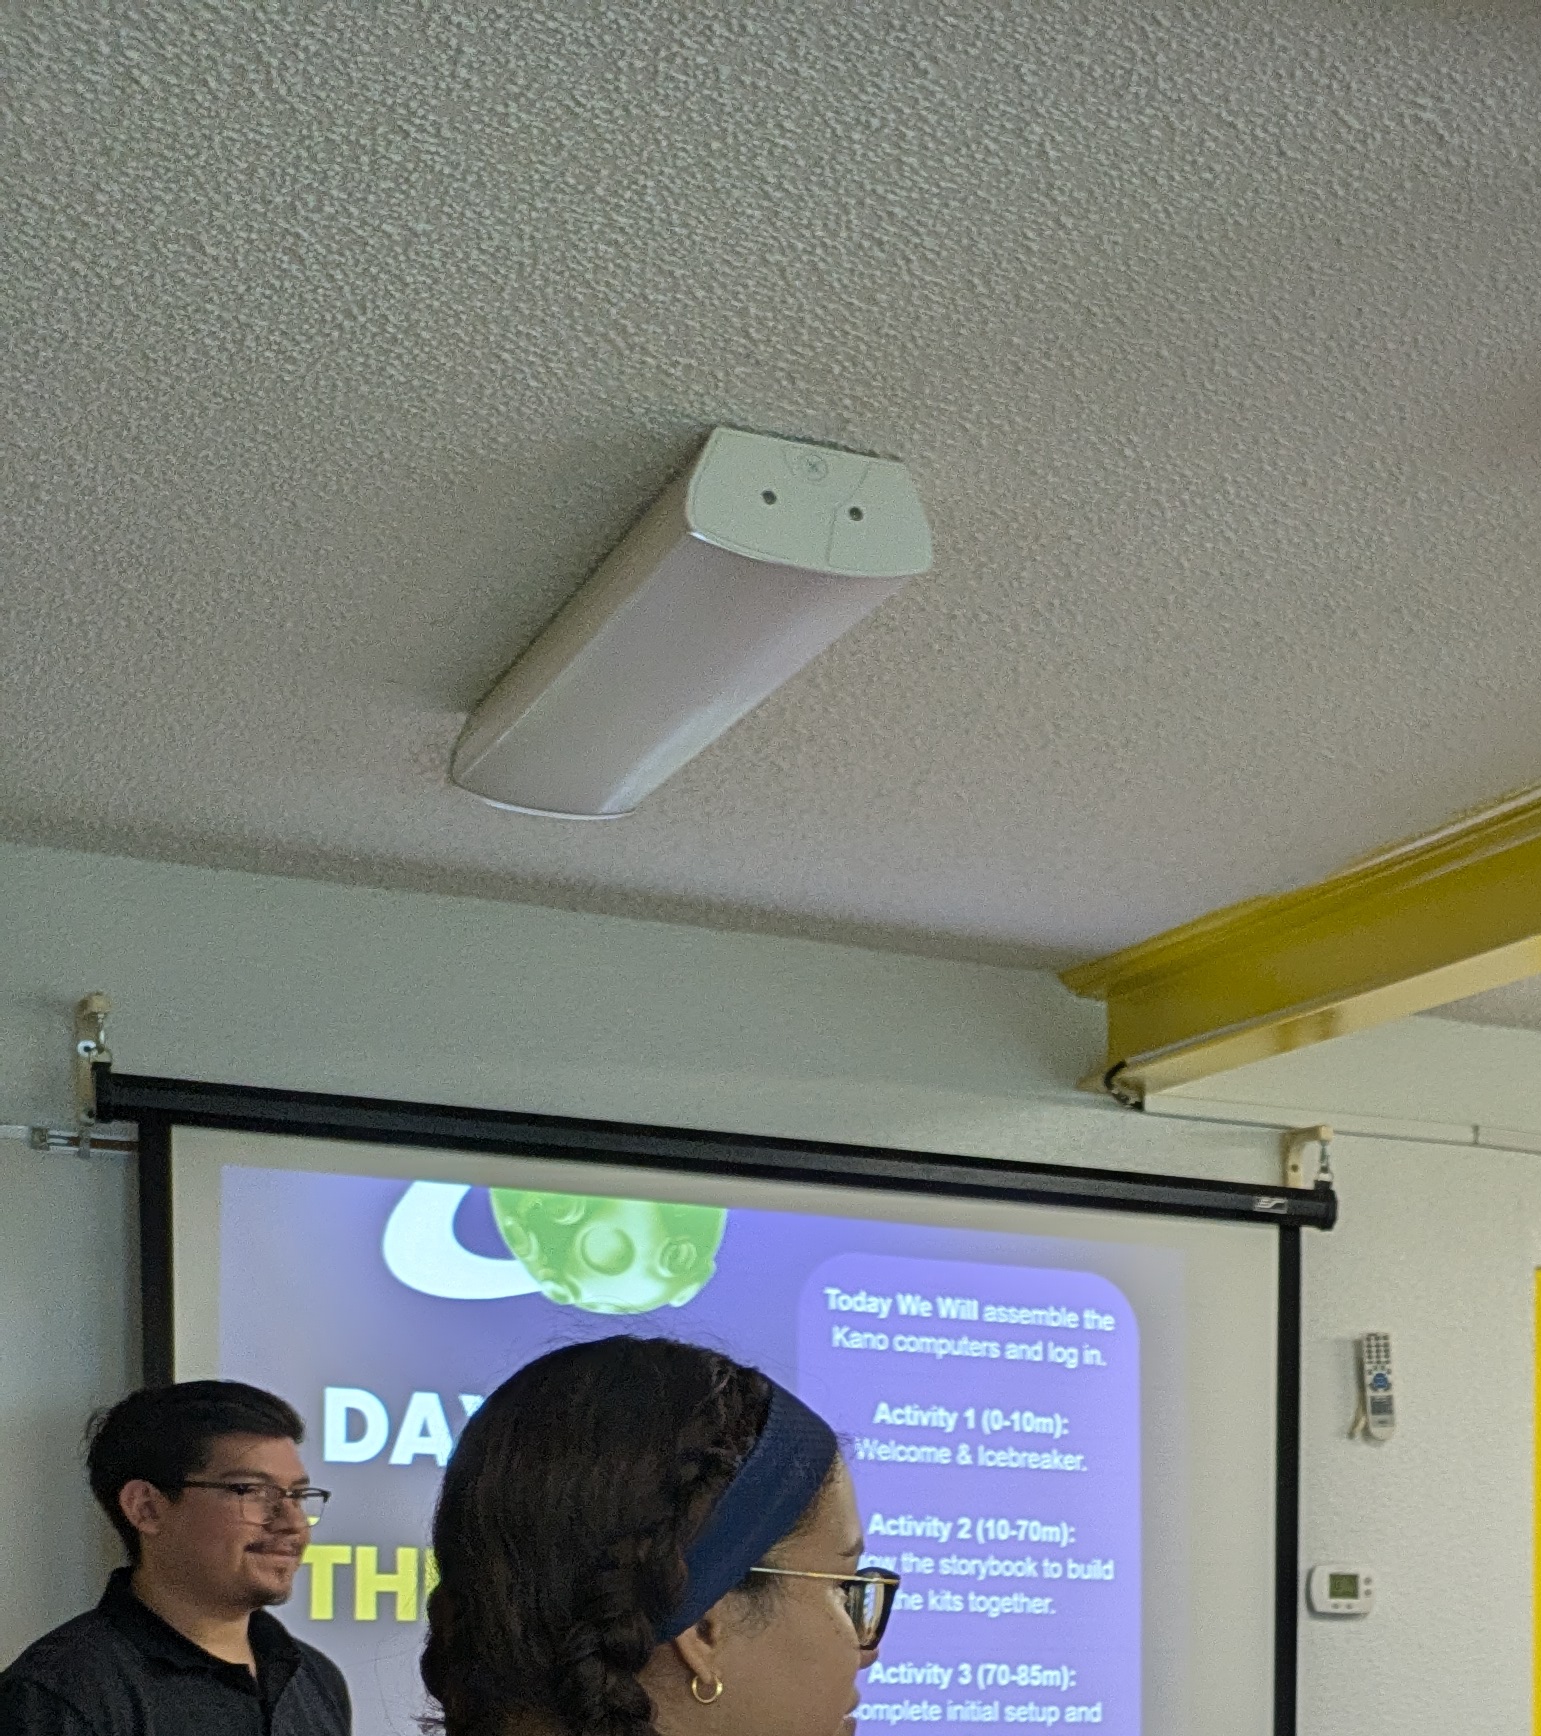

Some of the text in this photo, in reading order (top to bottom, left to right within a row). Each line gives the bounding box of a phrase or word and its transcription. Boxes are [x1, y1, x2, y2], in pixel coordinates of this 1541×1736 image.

[823, 1286, 1116, 1332] Today We Will assemble the
[831, 1325, 1107, 1369] Kano computers and log in.
[324, 1386, 487, 1468] DA
[873, 1402, 1070, 1439] Activity 1 (0-10m):
[855, 1437, 1088, 1472] Welcome & Icebreaker.
[868, 1513, 1076, 1548] Activity 2 (10-70m):
[901, 1552, 935, 1574] the
[939, 1555, 1038, 1581] storybook
[1042, 1558, 1062, 1578] to
[1066, 1558, 1115, 1580] build
[892, 1588, 1056, 1618] he kits together.
[867, 1661, 1077, 1691] Activity 3 (70-85m):
[947, 1700, 999, 1722] initial
[1004, 1702, 1060, 1727] setup
[1064, 1702, 1102, 1723] and
